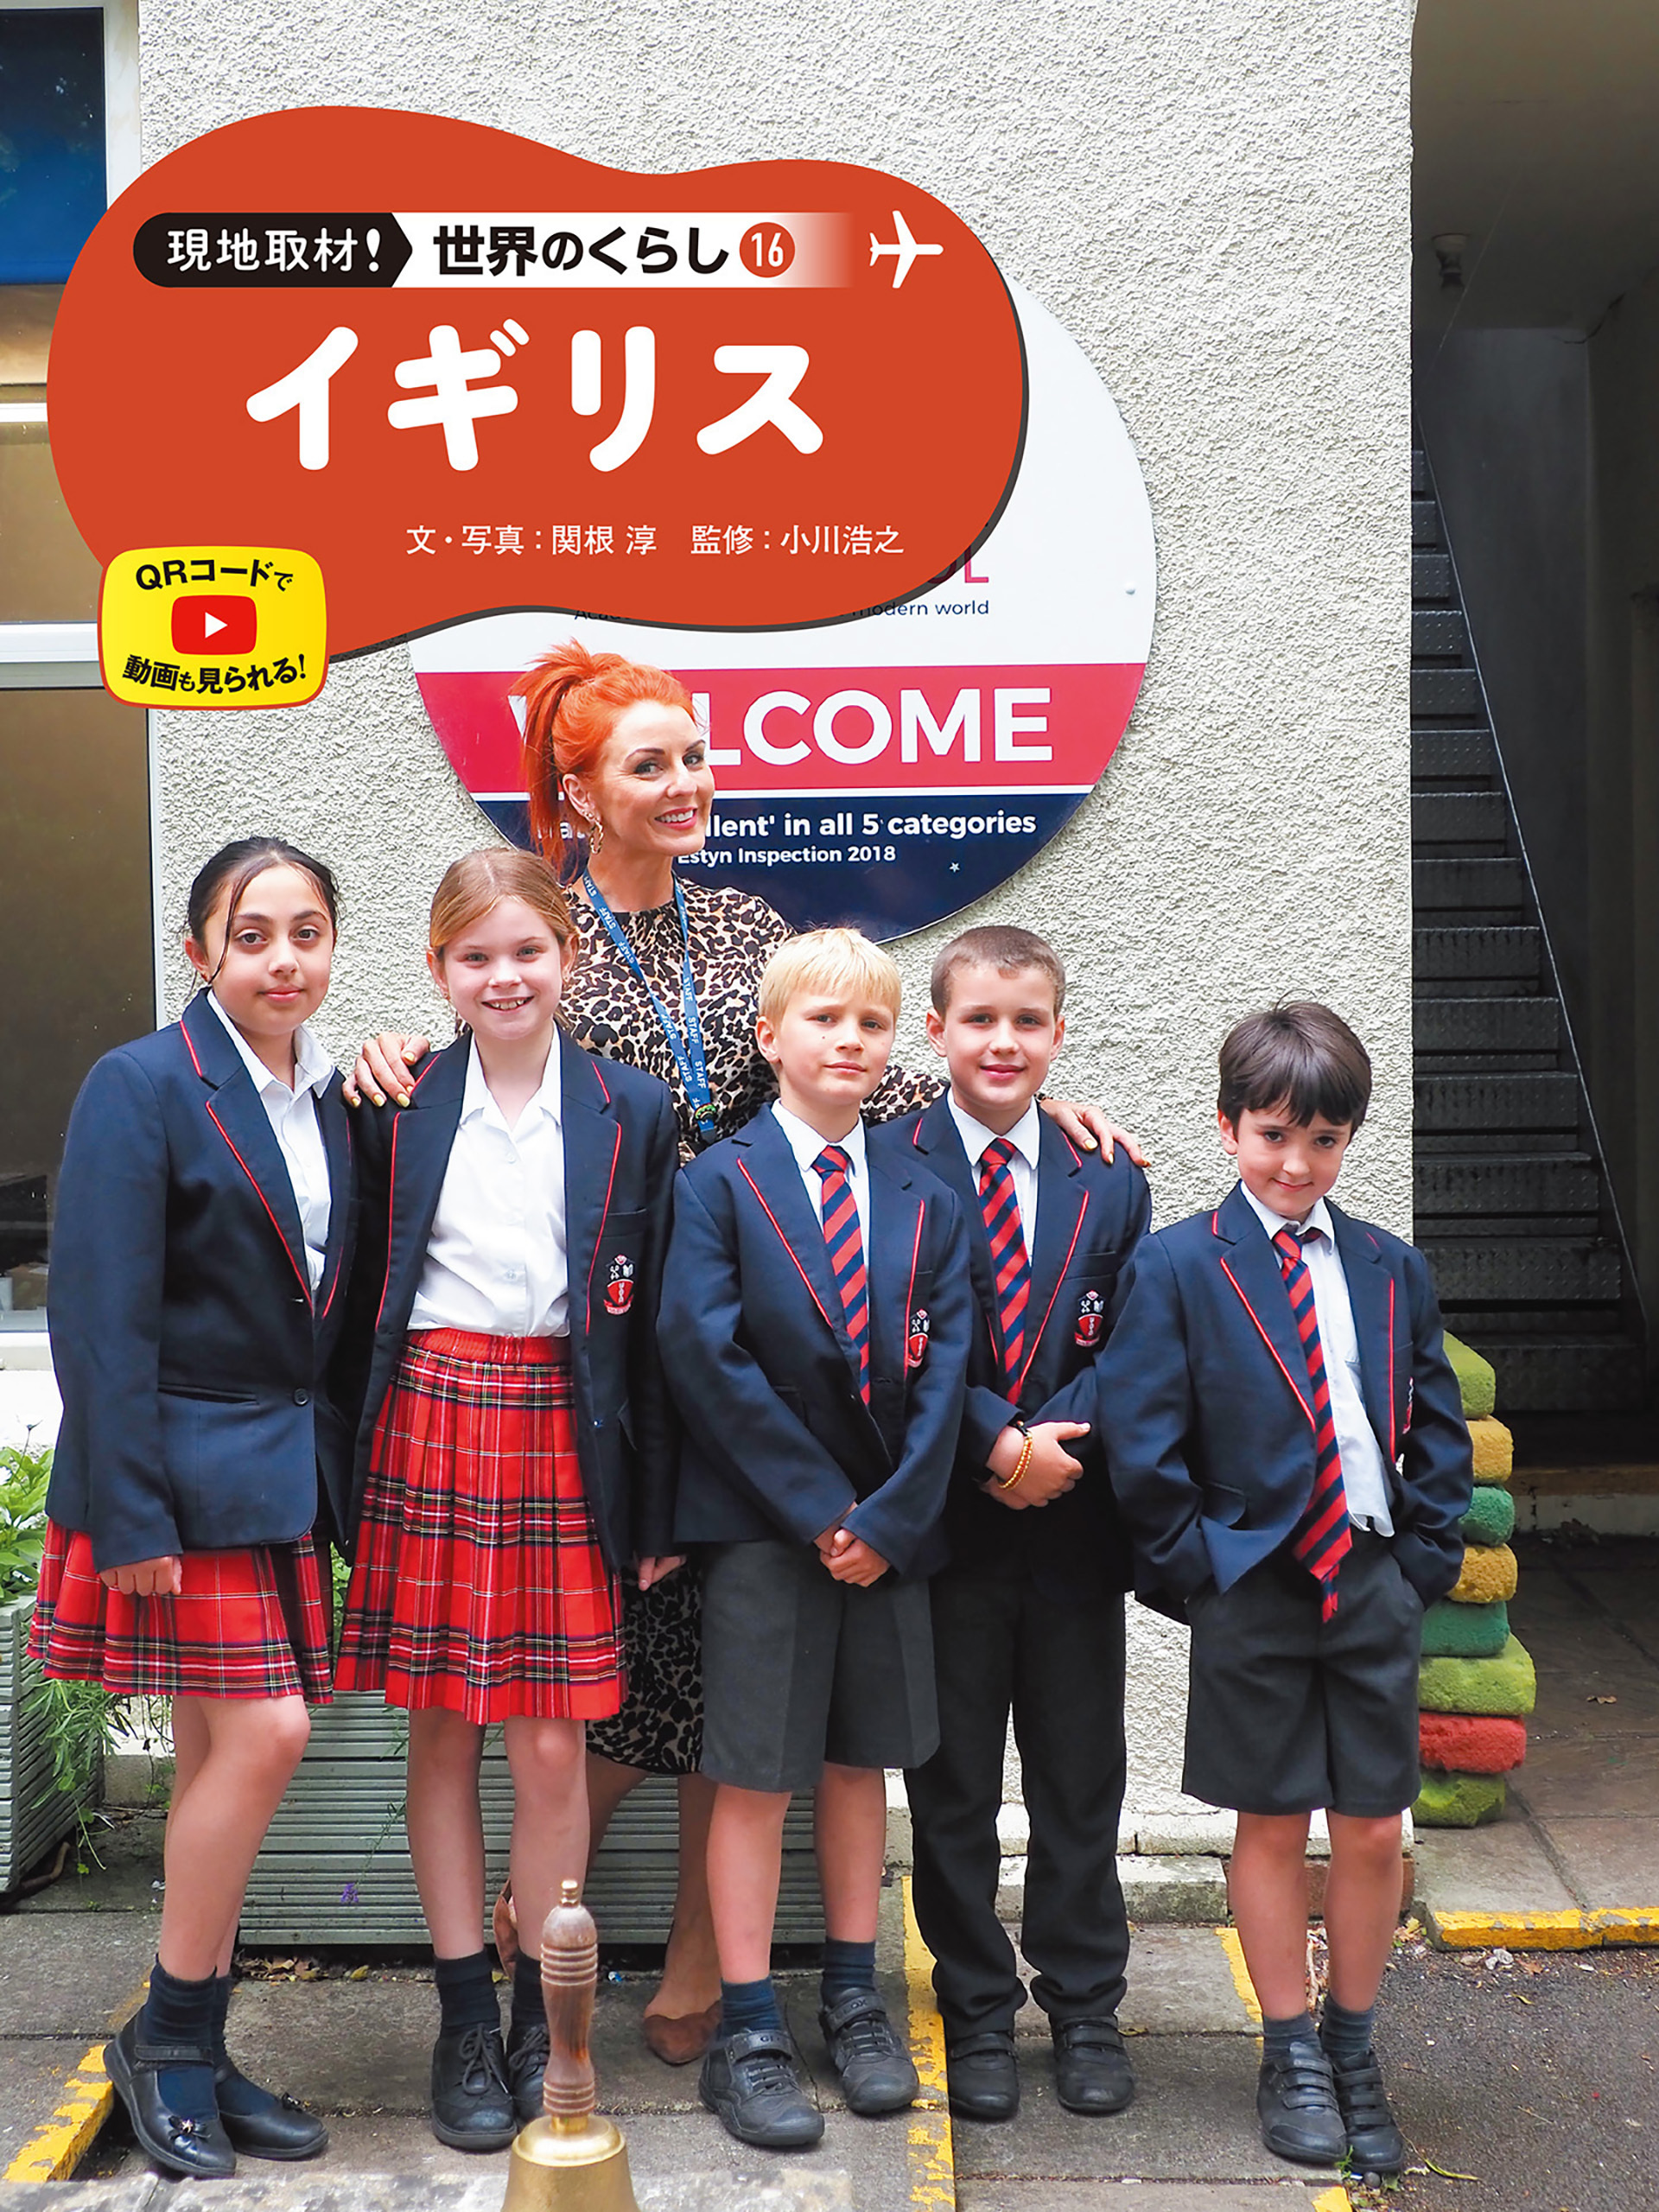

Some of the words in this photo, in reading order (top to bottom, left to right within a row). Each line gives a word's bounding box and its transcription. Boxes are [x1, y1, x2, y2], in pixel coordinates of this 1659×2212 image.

[935, 600, 989, 615] world
[507, 688, 1052, 766] LCOME
[703, 813, 775, 836] llent'
[785, 812, 810, 836] in
[819, 812, 853, 836] all
[861, 813, 880, 836] 5
[887, 810, 1037, 840] categories
[677, 848, 733, 868] Estyn
[738, 845, 842, 867] Inspection
[848, 845, 896, 862] 2018
[599, 906, 616, 930] STAFF
[618, 940, 635, 964] STAFF
[687, 1016, 700, 1045] STAFF
[677, 1054, 693, 1083] STAFF
[694, 1059, 707, 1090] STAFF
